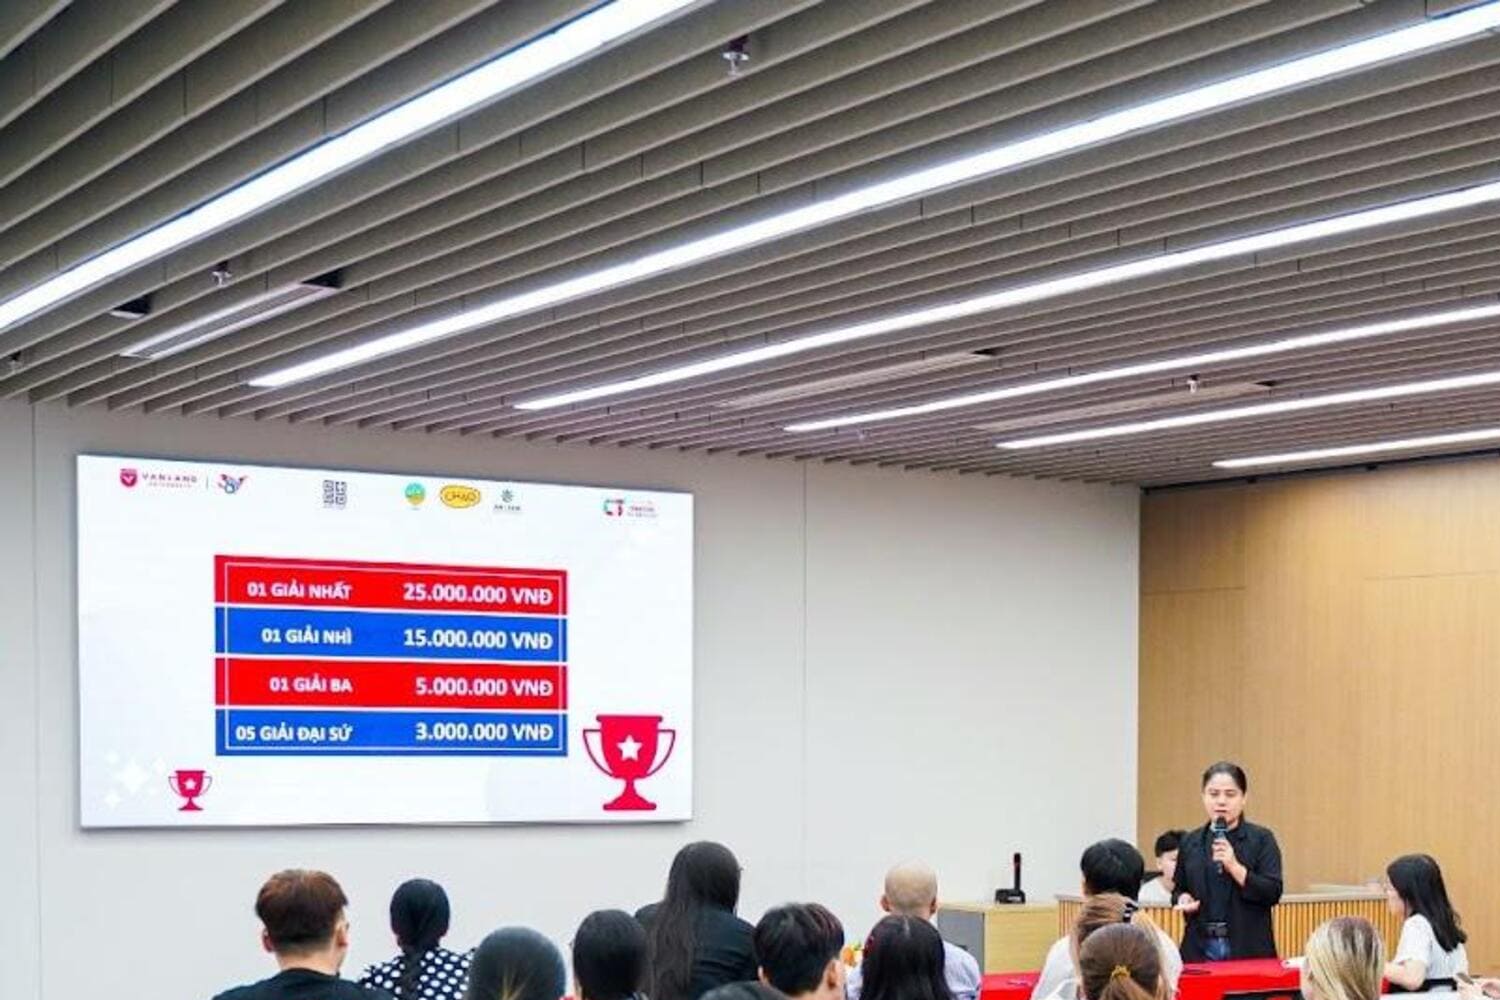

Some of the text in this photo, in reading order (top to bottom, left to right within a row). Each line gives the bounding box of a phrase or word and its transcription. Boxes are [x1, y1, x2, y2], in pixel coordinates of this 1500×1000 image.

[247, 579, 352, 599] 01 GIẢI NHẤT
[403, 582, 553, 606] 25.000.000 VNĐ
[261, 625, 352, 644] 01 GIẢI NHÌ
[404, 629, 554, 650] 15.000.000 VNĐ
[269, 673, 353, 693] 01 GIẢI BA
[415, 676, 554, 697] 5.000.000 VNĐ
[235, 722, 353, 743] 05 GIẢI ĐẠI SỨ
[416, 722, 554, 741] 3.000.000 VNĐ
